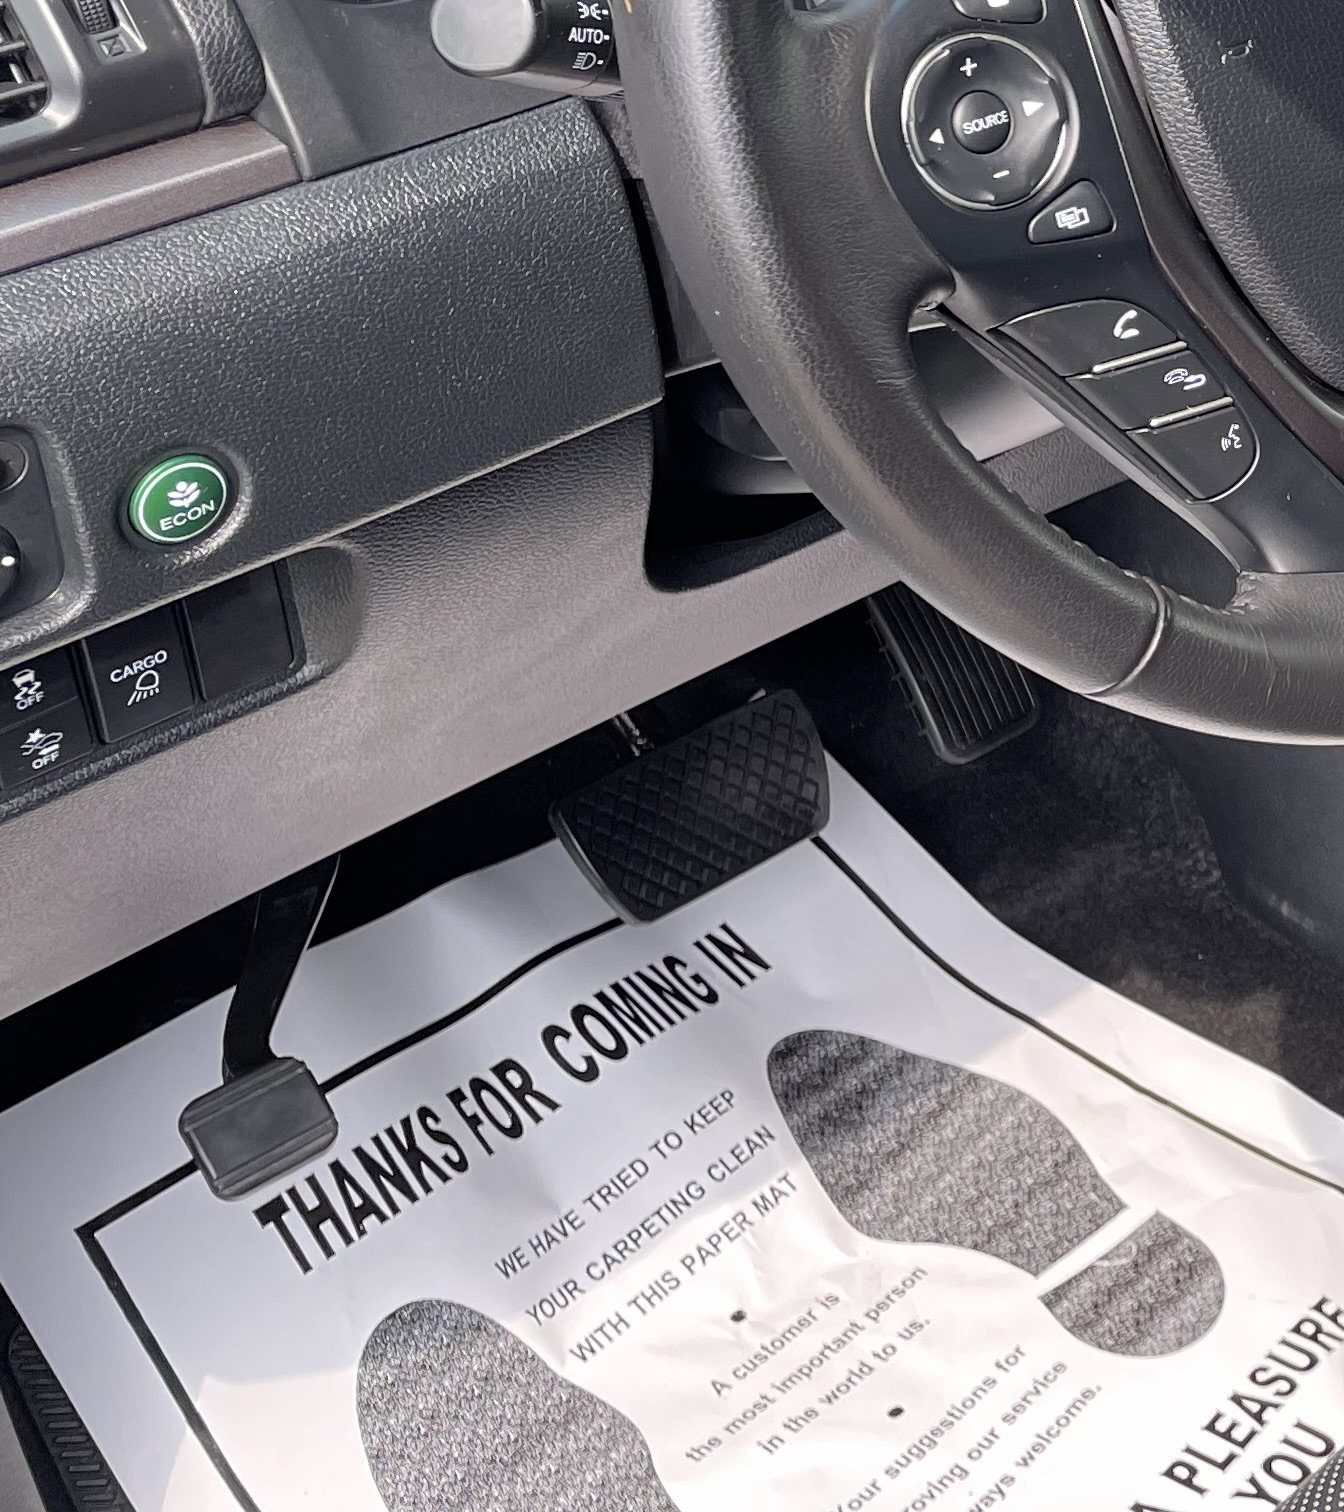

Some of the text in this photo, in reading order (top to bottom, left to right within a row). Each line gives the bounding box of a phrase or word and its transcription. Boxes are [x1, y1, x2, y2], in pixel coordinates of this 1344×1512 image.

[568, 27, 604, 44] AUTO
[962, 110, 1009, 135] SOURCE
[160, 500, 214, 530] ECON
[16, 690, 45, 710] OFF
[110, 650, 167, 682] CARGO
[31, 750, 60, 769] OFF
[252, 922, 772, 1274] THANKS FOR COMING IN
[494, 1089, 735, 1280] WE HAVE TRIED TO KEEP
[525, 1124, 776, 1327] YOUR CARPETING CLEAN
[568, 1172, 798, 1364] WITH THIS PAPER MAT
[684, 1266, 929, 1463] the most important person
[709, 1292, 841, 1398] A customer is
[757, 1318, 931, 1456] in the world to us.
[884, 1375, 998, 1480] suggestions
[995, 1343, 1027, 1374] for
[966, 1426, 1001, 1463] our
[1000, 1361, 1068, 1426] service
[1014, 1385, 1103, 1469] welcome.
[1230, 1418, 1336, 1508] YOU
